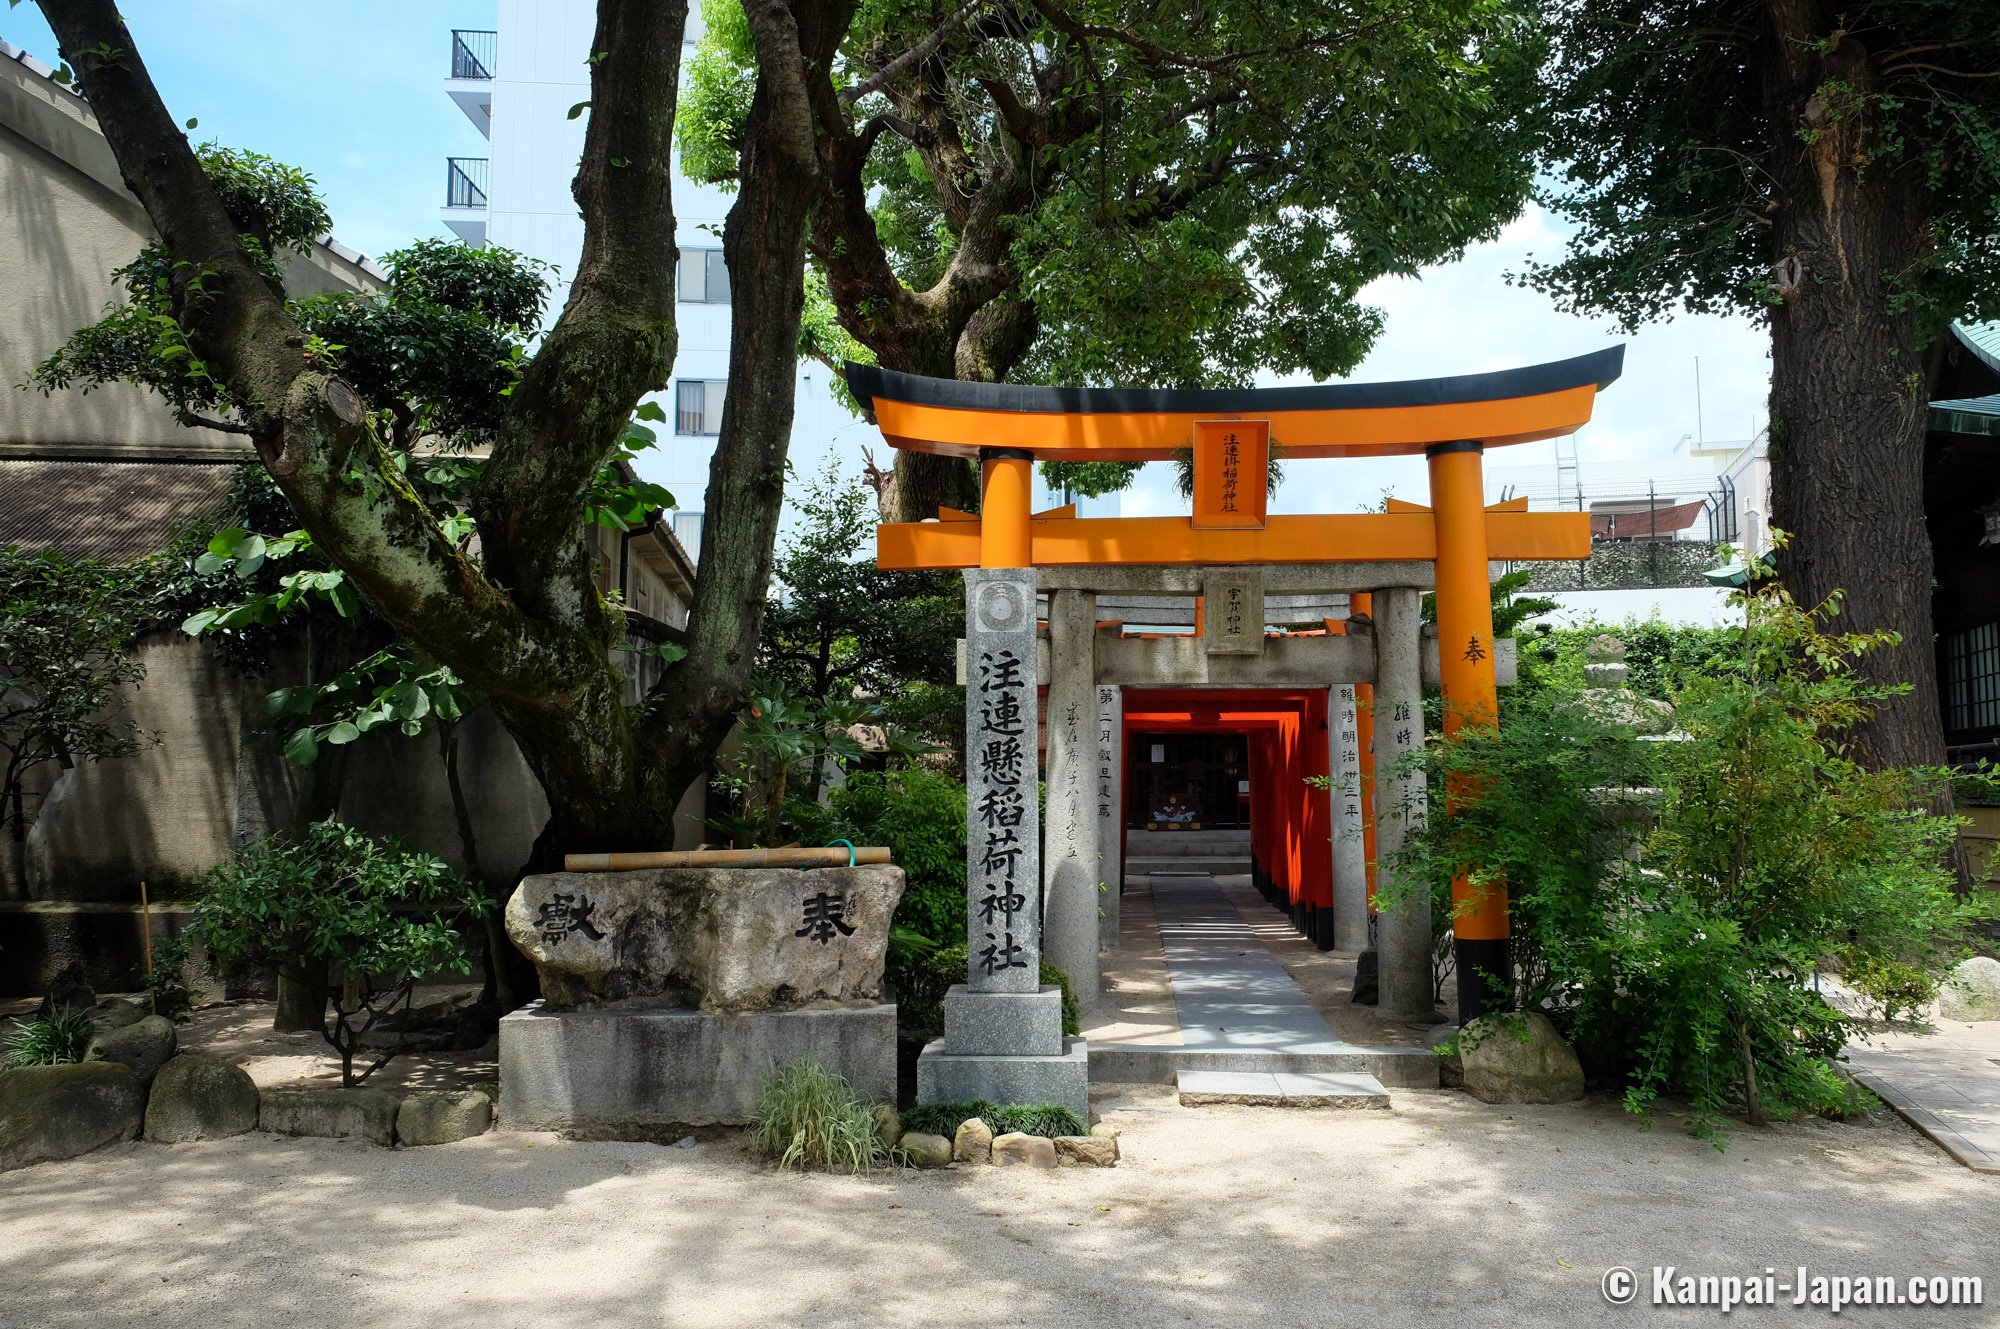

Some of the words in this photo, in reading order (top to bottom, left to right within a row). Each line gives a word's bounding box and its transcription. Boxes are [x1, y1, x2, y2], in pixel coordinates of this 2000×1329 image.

[1226, 587, 1241, 635] 宇賀神社
[1461, 636, 1487, 666] 奉
[795, 892, 856, 946] 奉
